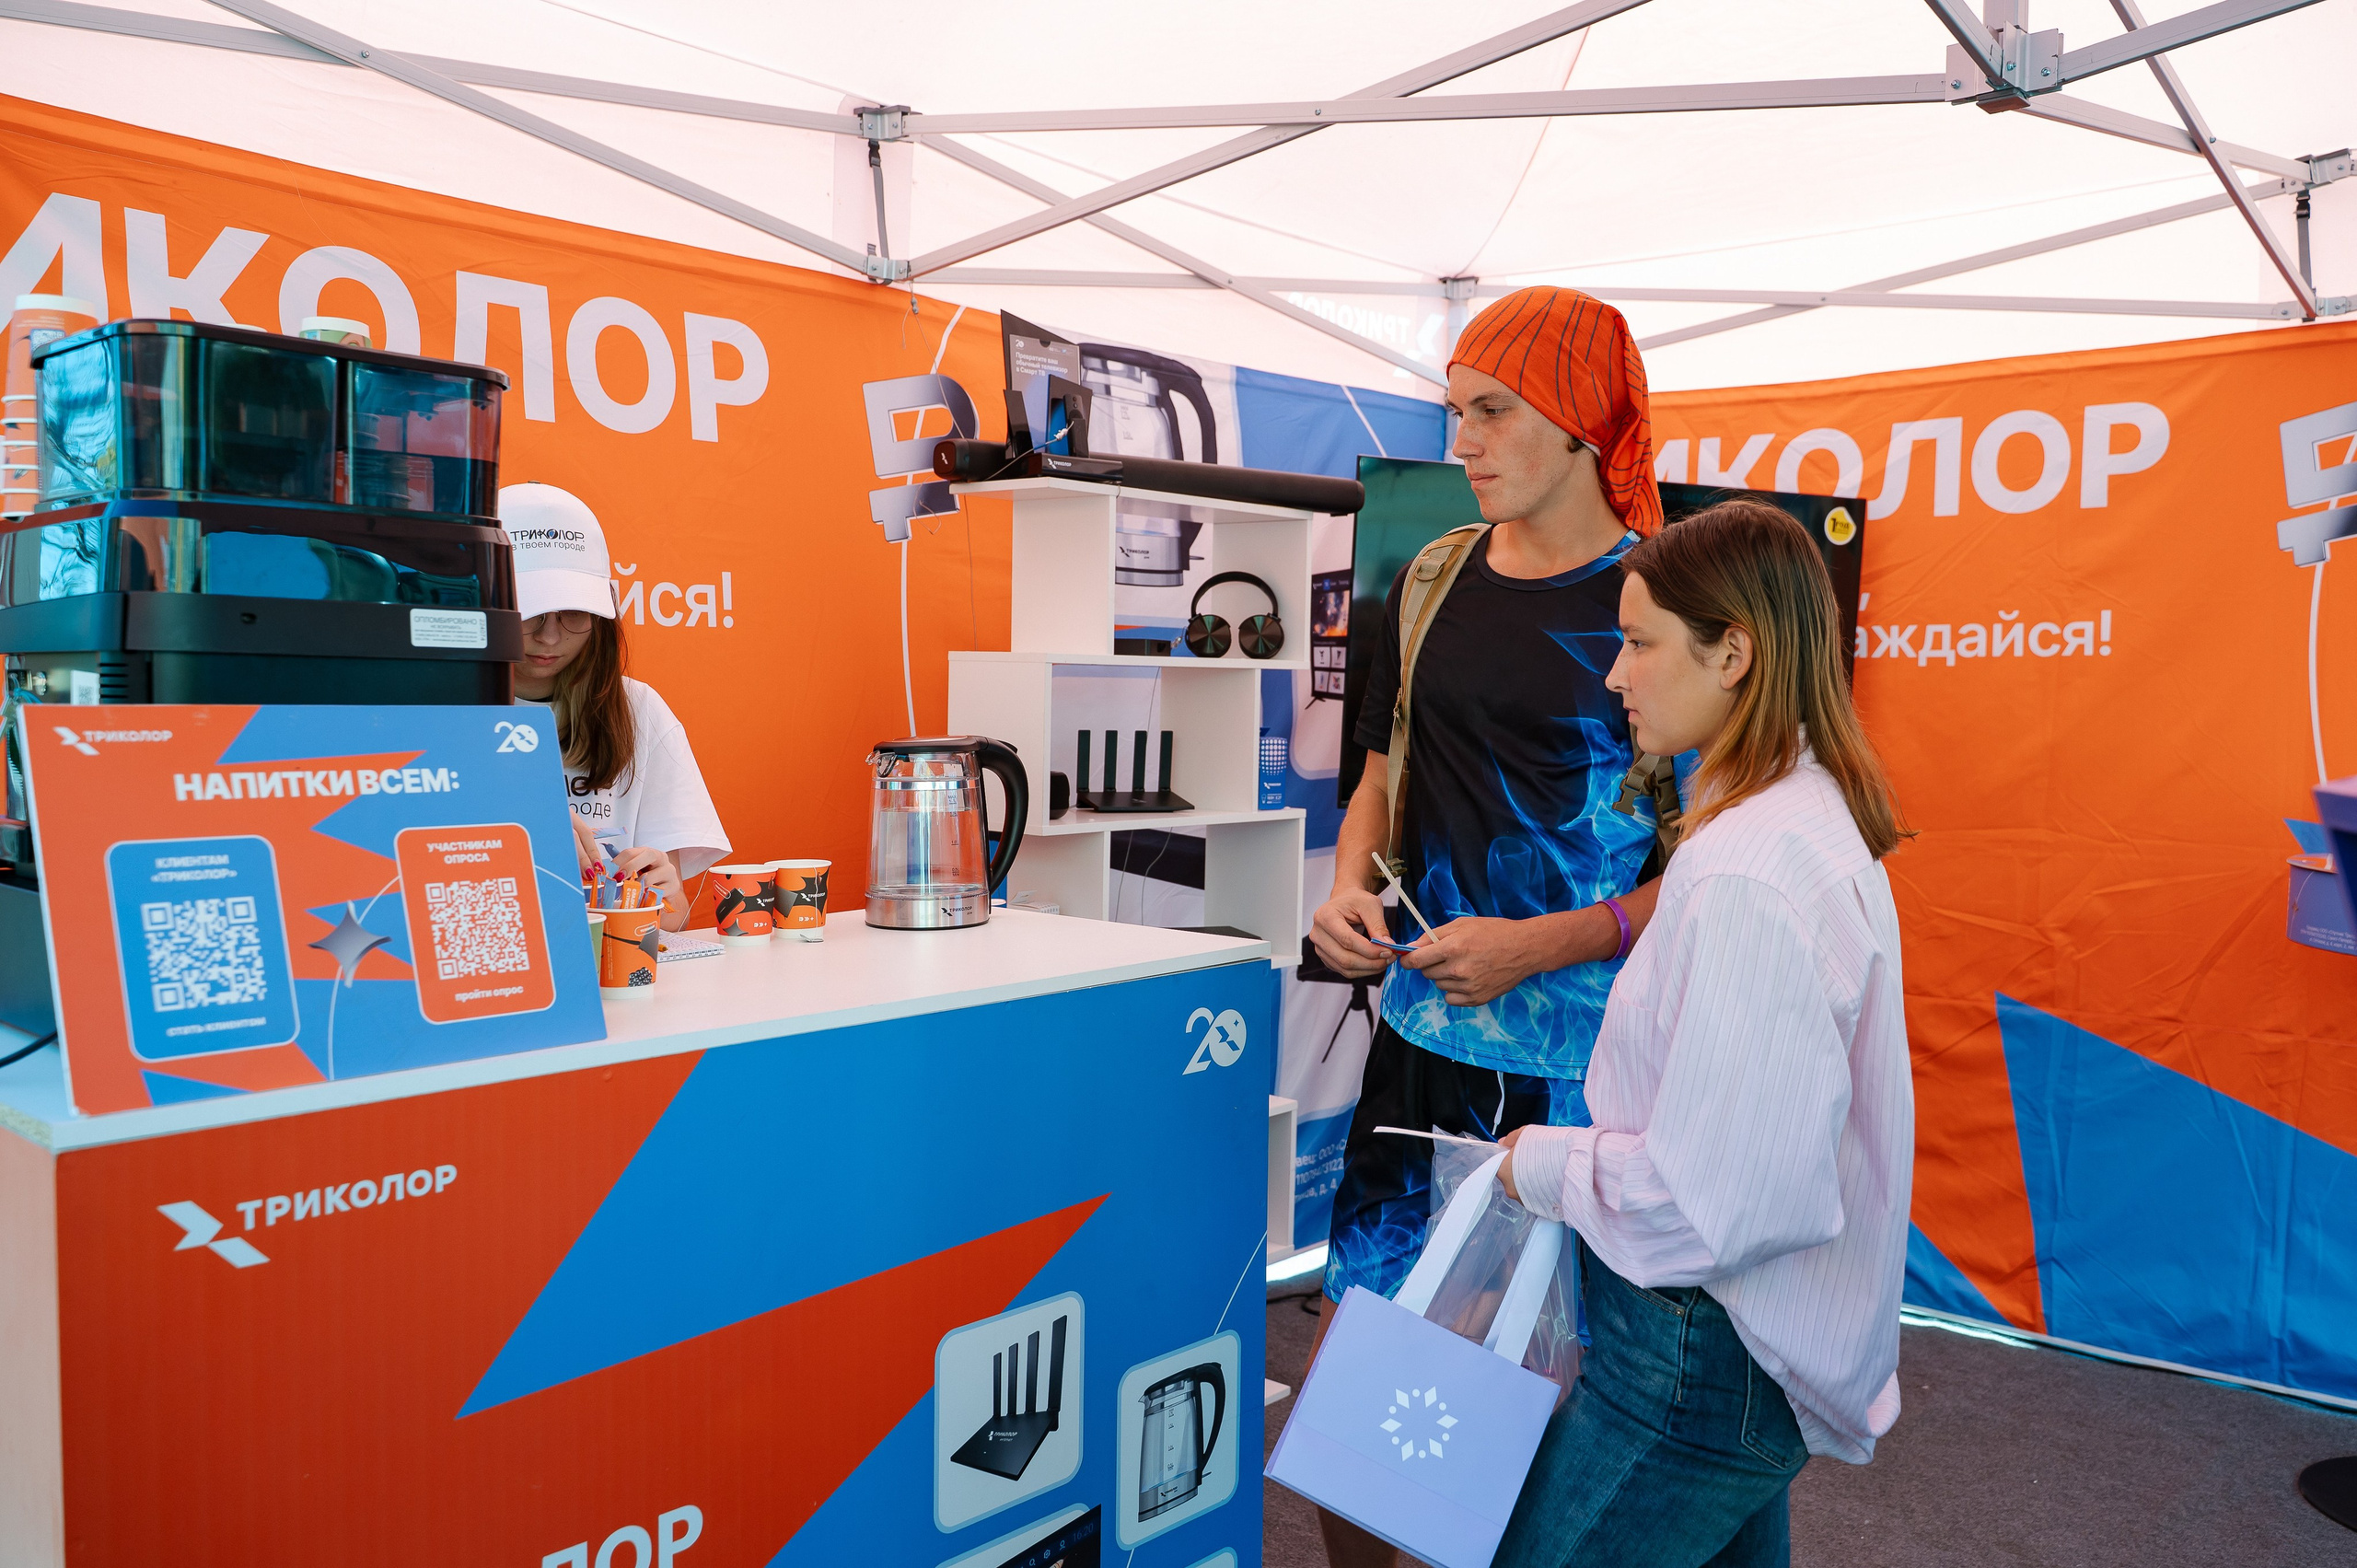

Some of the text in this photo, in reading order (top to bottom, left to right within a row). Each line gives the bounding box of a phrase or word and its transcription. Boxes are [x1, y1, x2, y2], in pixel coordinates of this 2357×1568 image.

[520, 540, 552, 550] твоем
[554, 540, 586, 552] городе
[82, 729, 173, 743] ТРИКОЛОР
[173, 767, 460, 801] НАПИТКИ ВСЕМ:
[426, 839, 503, 854] УЧАСТНИКАМ
[444, 853, 491, 865] ОПРОСА
[455, 985, 524, 1004] пройти опрос
[236, 1164, 458, 1231] ТРИКОЛОР
[1073, 1522, 1094, 1542] 16:20
